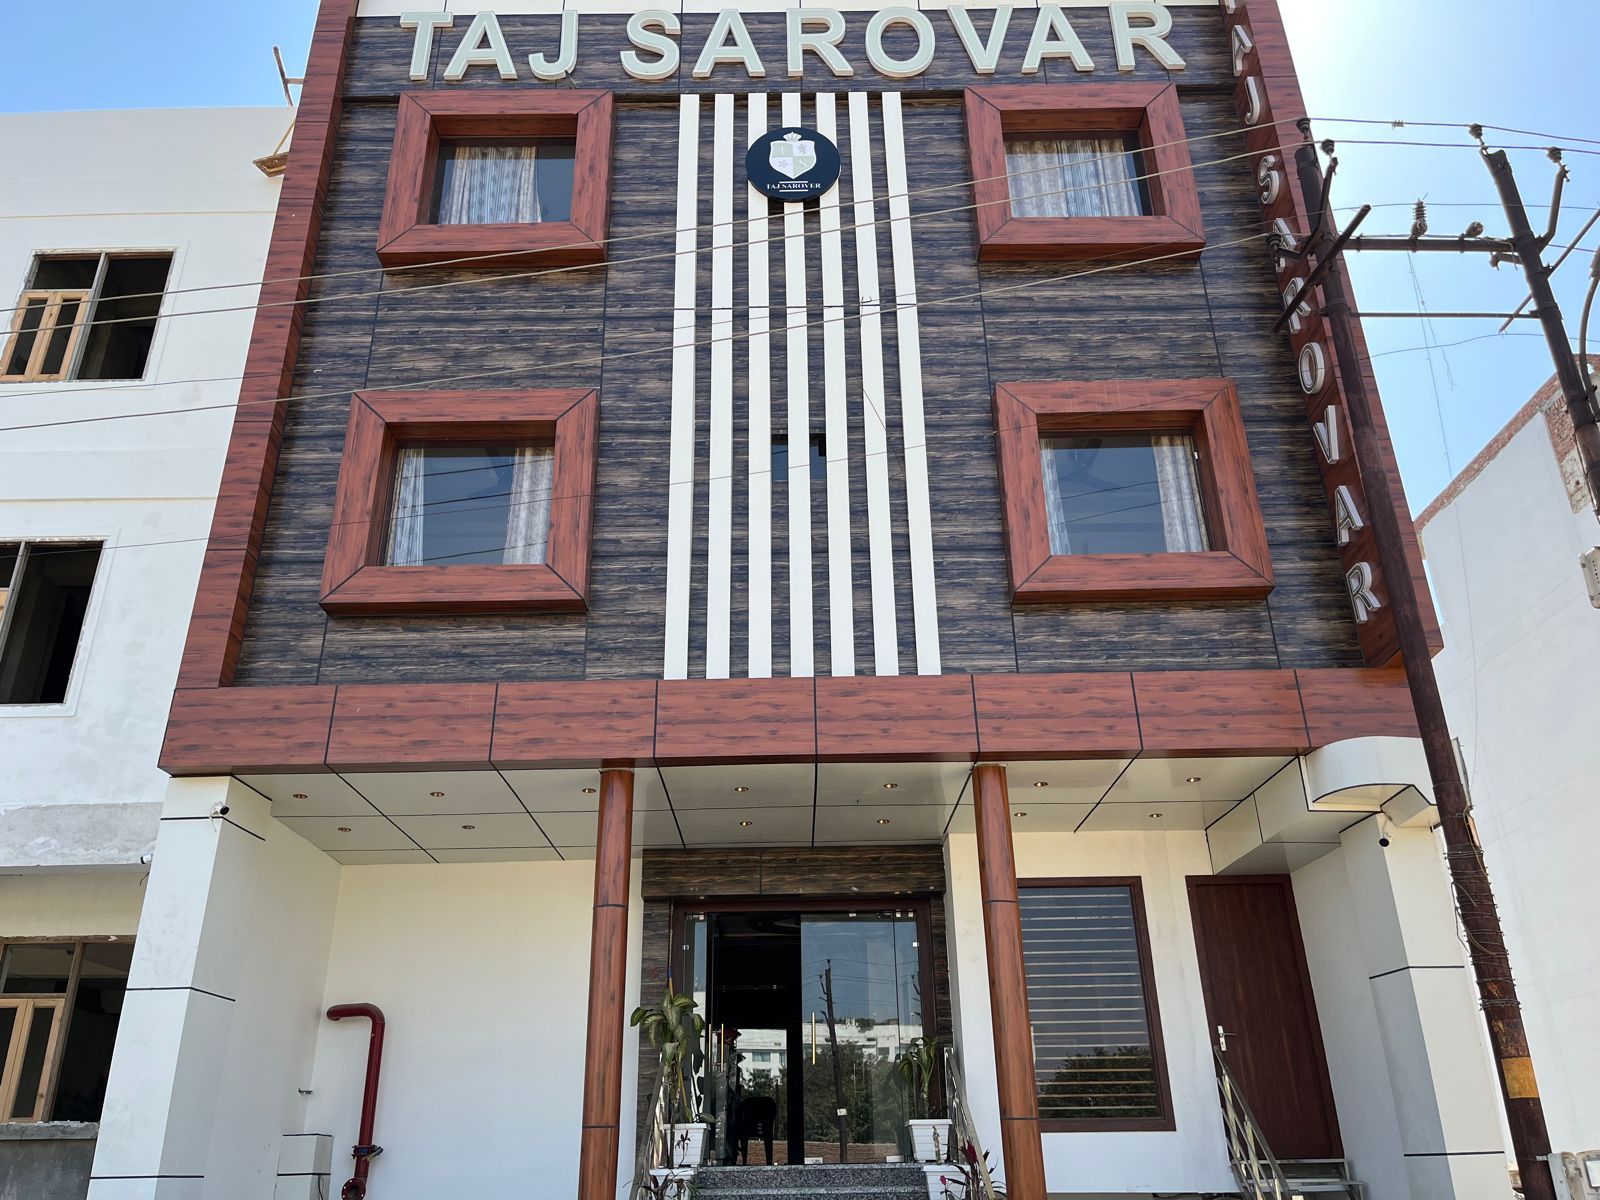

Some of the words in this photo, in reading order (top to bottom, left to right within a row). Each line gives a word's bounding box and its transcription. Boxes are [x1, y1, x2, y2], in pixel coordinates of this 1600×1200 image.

[400, 9, 579, 81] TAJ
[620, 2, 1186, 80] SAROVAR
[1223, 0, 1261, 126] AJ
